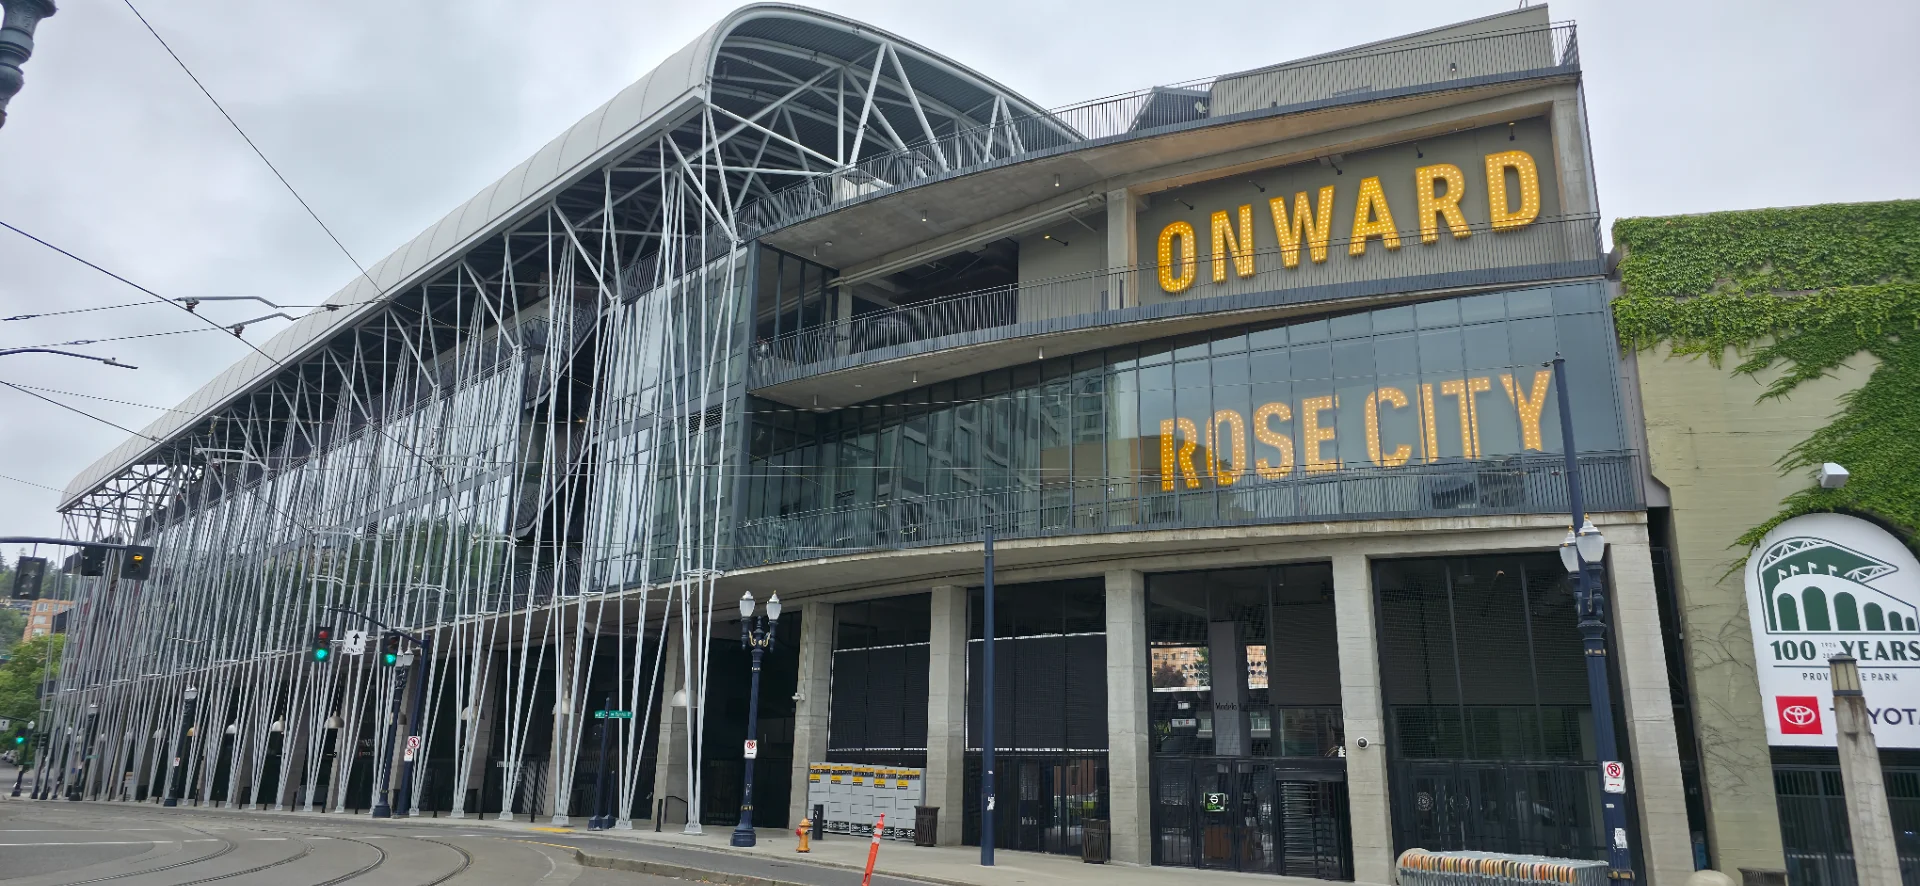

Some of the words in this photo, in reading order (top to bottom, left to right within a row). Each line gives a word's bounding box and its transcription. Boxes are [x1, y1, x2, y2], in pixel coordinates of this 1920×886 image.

[1157, 150, 1541, 293] ONWARD
[1159, 394, 1344, 492] ROSE
[1364, 370, 1553, 468] CITY
[1770, 640, 1816, 660] 100
[1871, 672, 1899, 681] PARK
